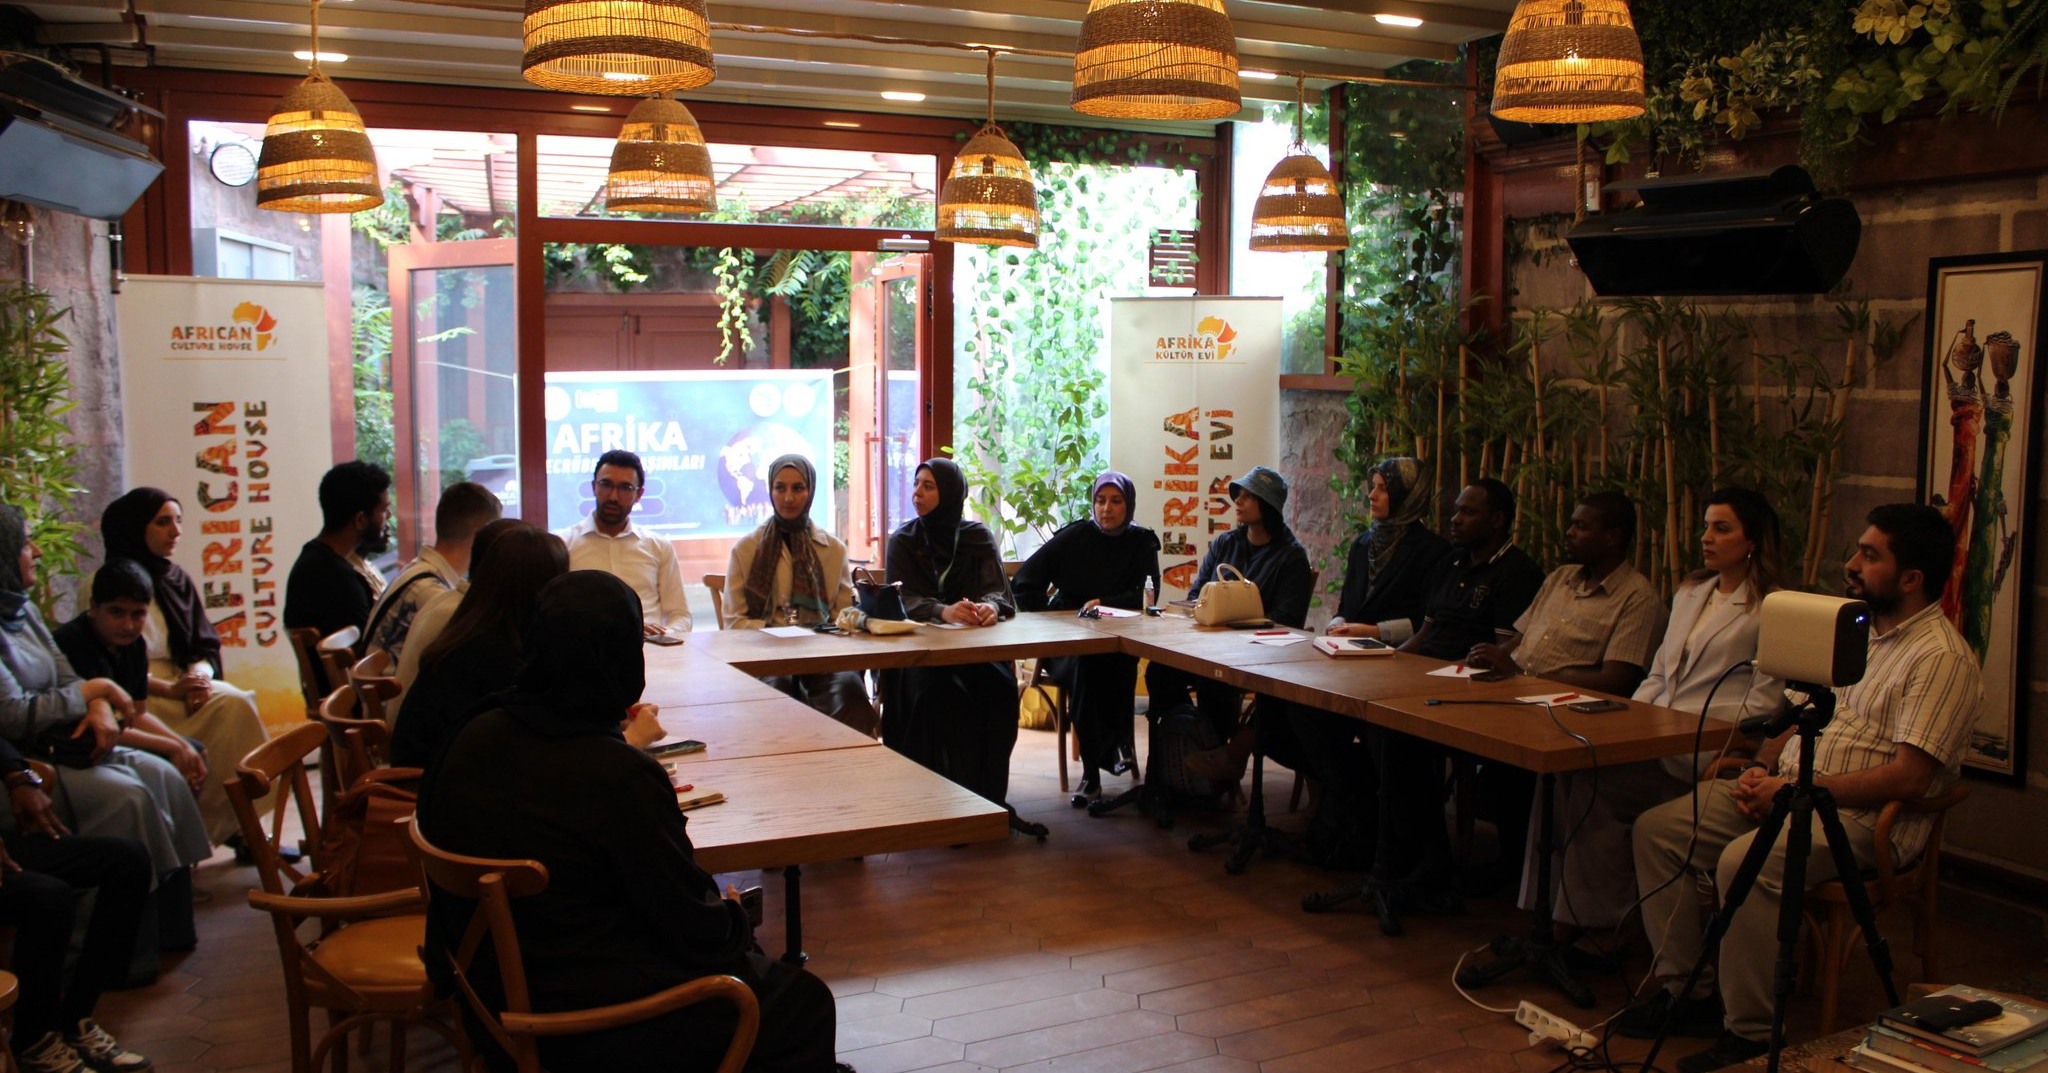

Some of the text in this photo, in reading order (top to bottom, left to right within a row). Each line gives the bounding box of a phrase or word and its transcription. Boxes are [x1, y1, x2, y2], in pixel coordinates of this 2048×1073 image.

[171, 326, 252, 340] AFRICAN
[171, 342, 252, 351] CULTURE HOUSE
[1156, 334, 1216, 349] AFRİKA
[1155, 350, 1215, 360] KÜLTÜR EVİ
[553, 415, 687, 454] AFRİKA
[1204, 409, 1234, 545] TÜR EVİ
[1154, 406, 1200, 590] AFRİKA
[193, 401, 247, 648] AFRICAN
[244, 401, 277, 648] CULTURE HOUSE
